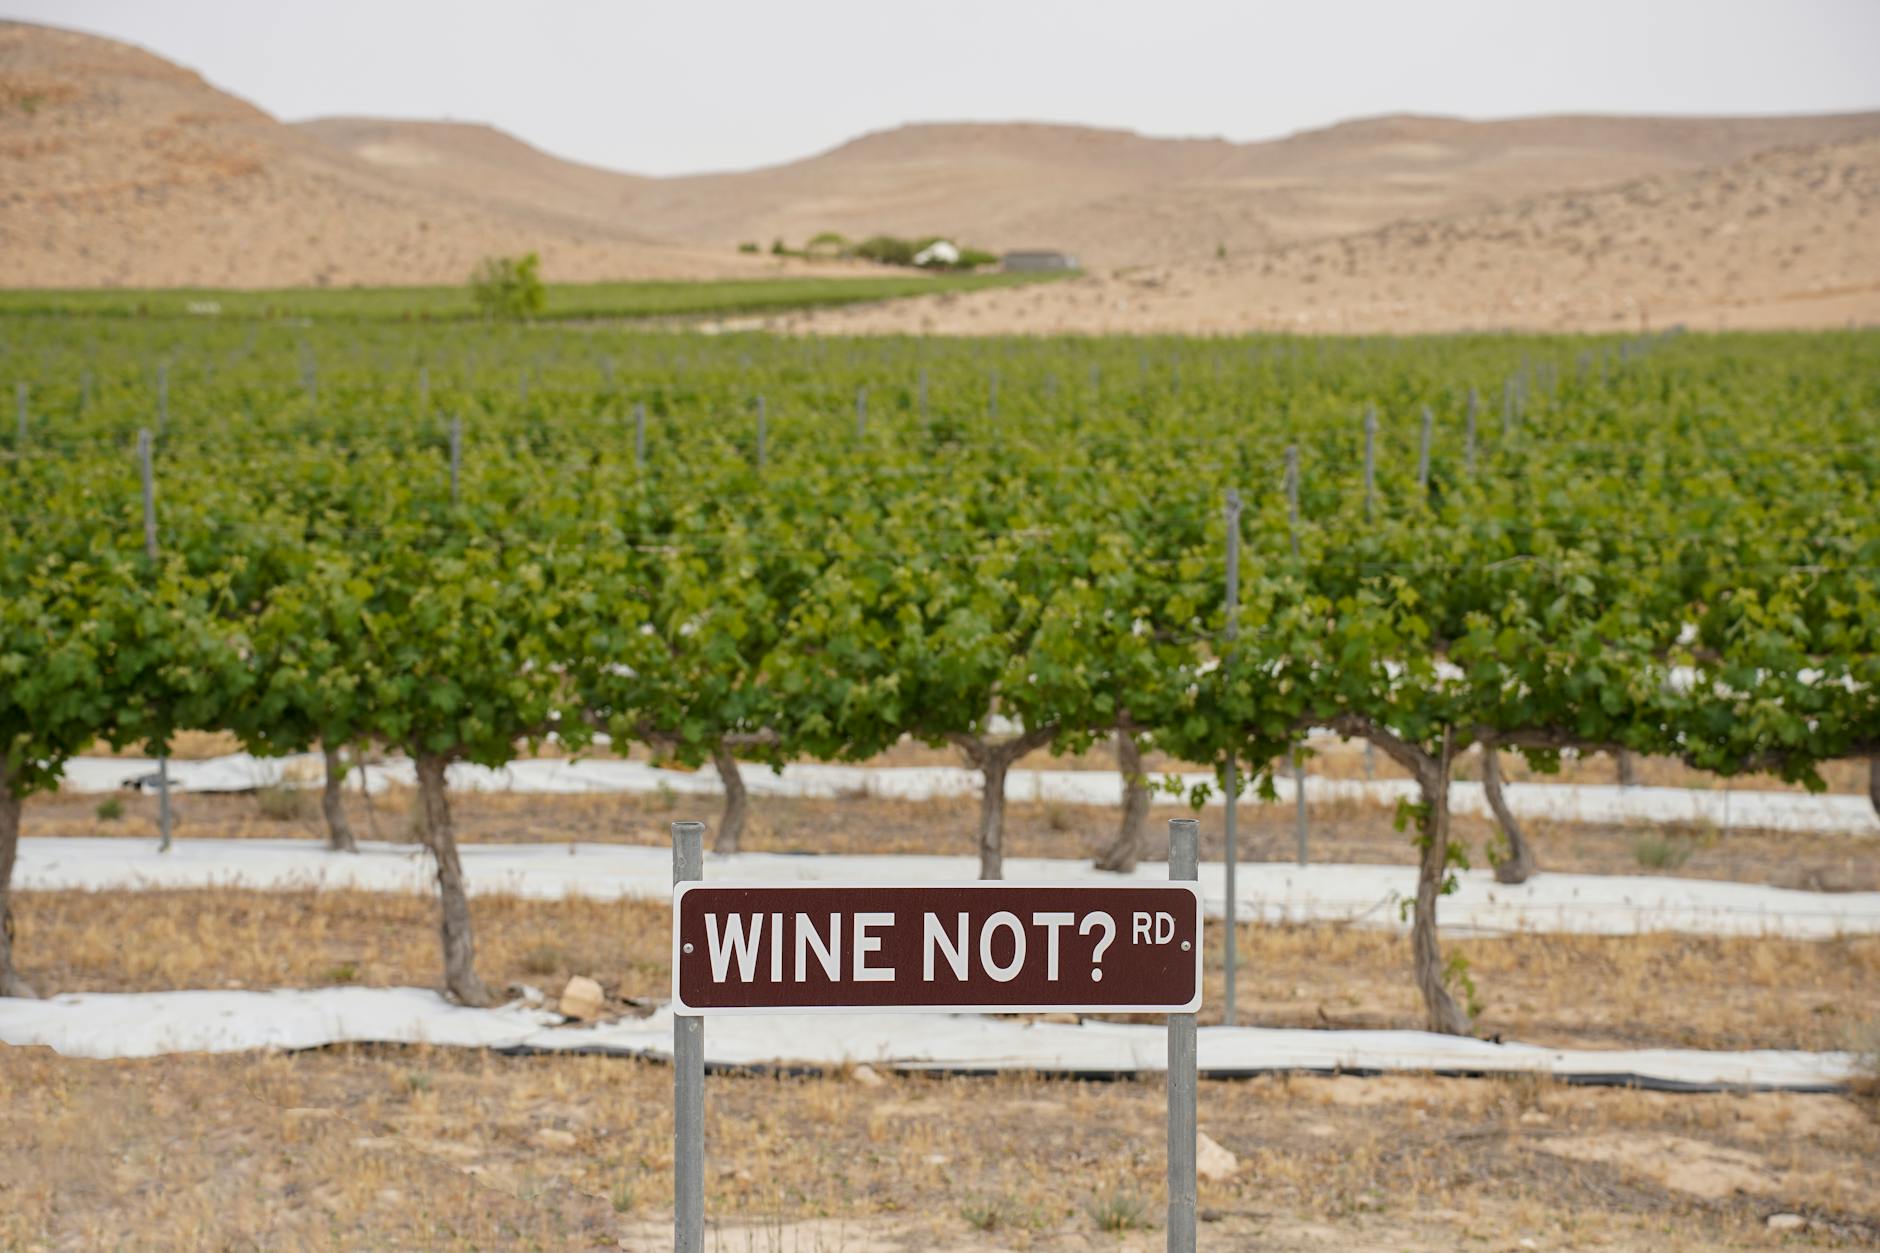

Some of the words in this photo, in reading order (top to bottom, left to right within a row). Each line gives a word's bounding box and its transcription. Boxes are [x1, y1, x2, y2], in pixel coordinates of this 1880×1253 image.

[704, 912, 896, 983] WINE
[923, 910, 1117, 983] NOT?
[1132, 911, 1176, 945] RD
